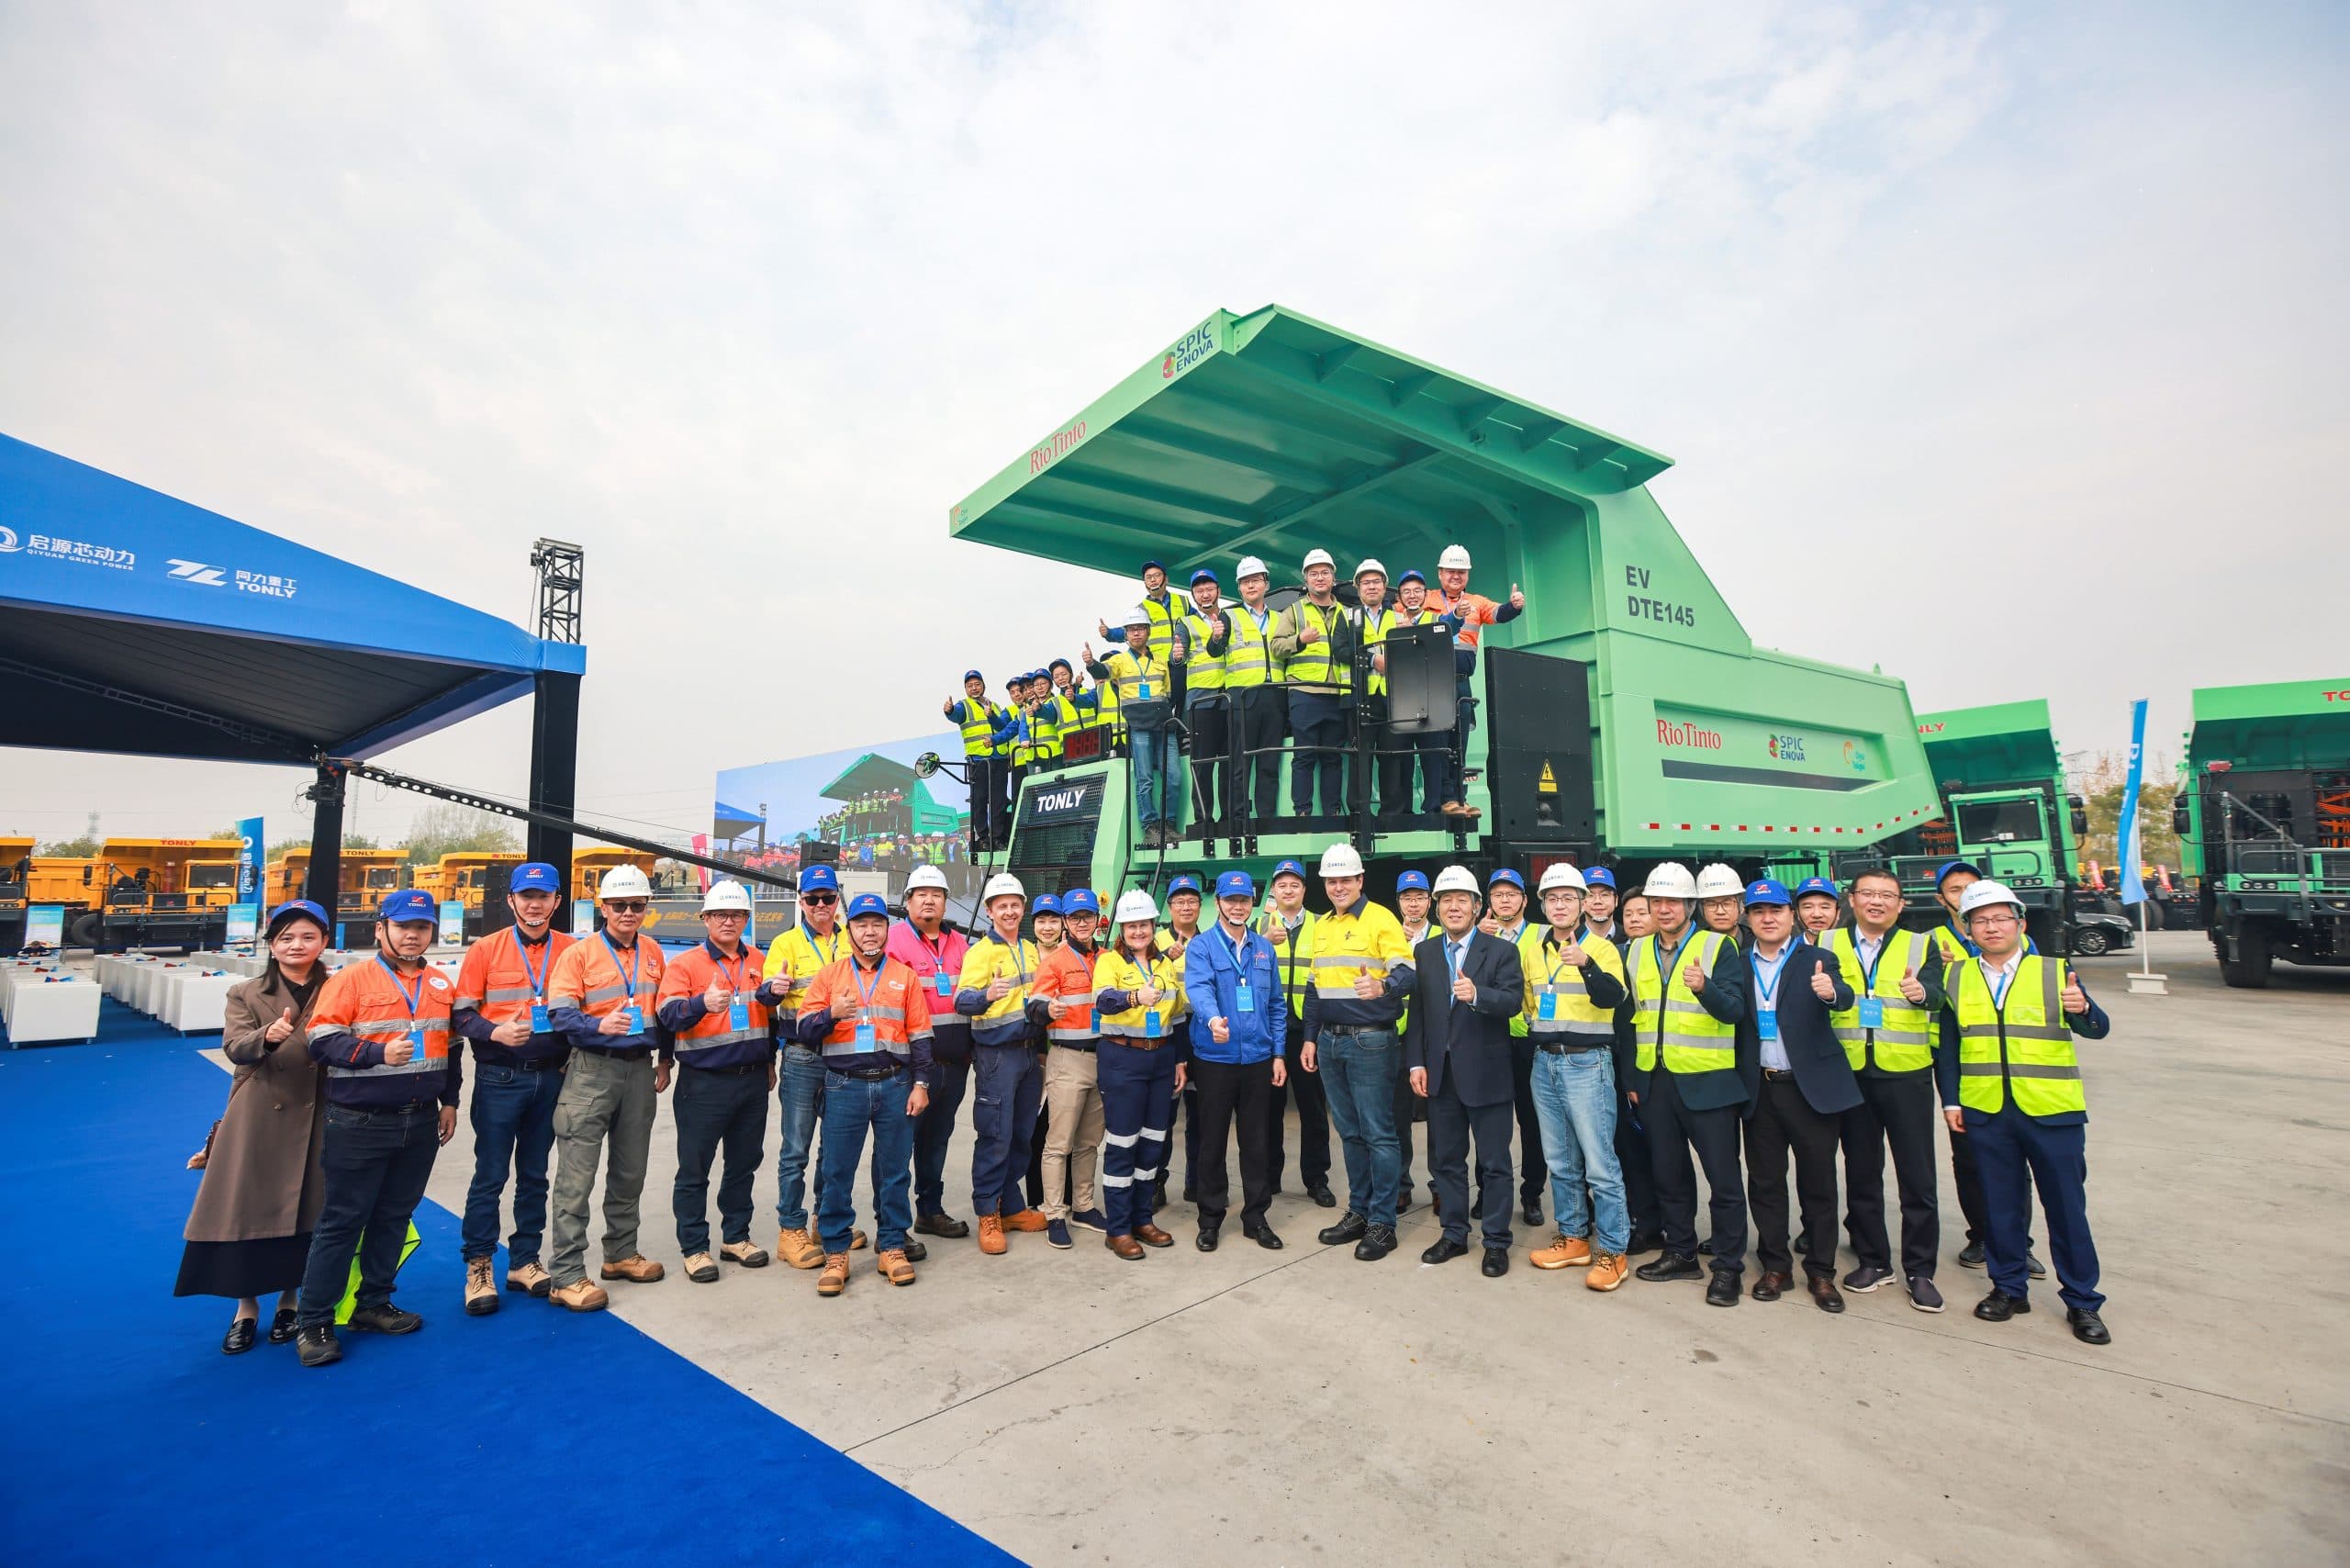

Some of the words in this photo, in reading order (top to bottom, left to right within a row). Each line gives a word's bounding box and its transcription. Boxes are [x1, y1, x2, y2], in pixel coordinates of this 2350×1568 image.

[1176, 321, 1212, 359] SPIC
[1176, 340, 1214, 372] ENOVA
[27, 548, 65, 559] QIYUAN
[68, 555, 99, 566] GREEN
[103, 561, 134, 571] POWER
[28, 534, 135, 565] 启源芯动力
[236, 569, 297, 589] 同力重工
[1626, 565, 1651, 589] EV
[235, 580, 297, 599] TONLY
[1628, 595, 1695, 627] DTE145
[1780, 735, 1804, 751] SPIC
[1780, 750, 1806, 762] ENOVA
[1037, 789, 1086, 812] TONLY
